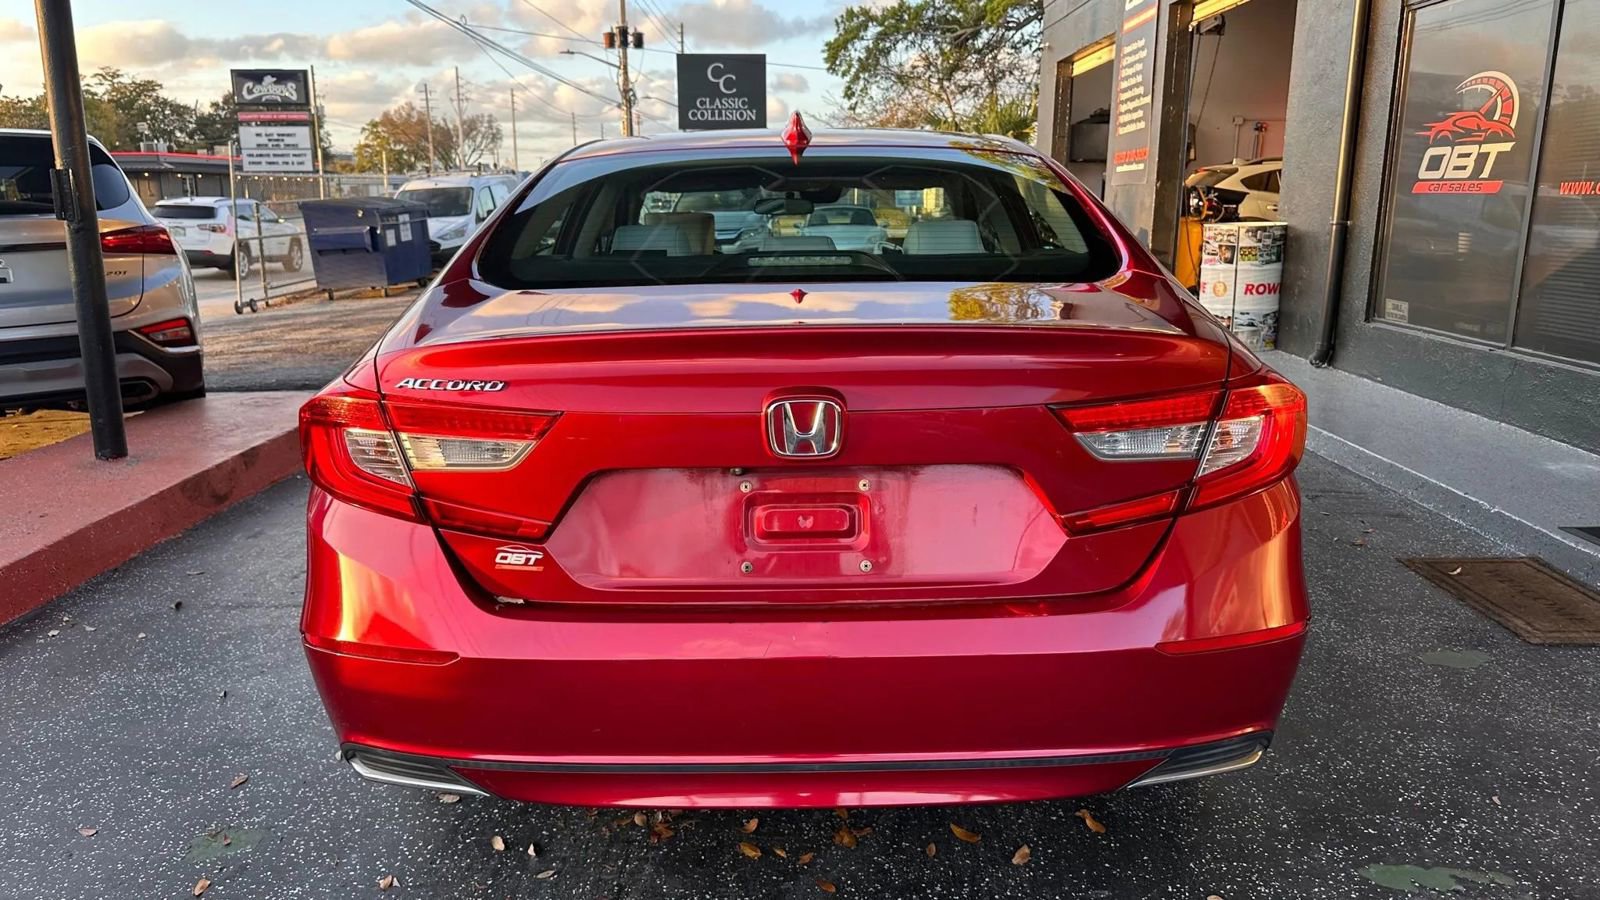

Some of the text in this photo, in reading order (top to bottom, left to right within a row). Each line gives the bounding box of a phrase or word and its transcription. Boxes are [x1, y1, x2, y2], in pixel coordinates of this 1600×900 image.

[696, 97, 749, 109] CLASSIC
[688, 109, 757, 121] COLLISION
[1417, 141, 1517, 180] OBT
[1428, 183, 1447, 192] car
[1244, 283, 1281, 296] ROW
[394, 377, 505, 392] ACCORD
[495, 552, 544, 566] OBT
